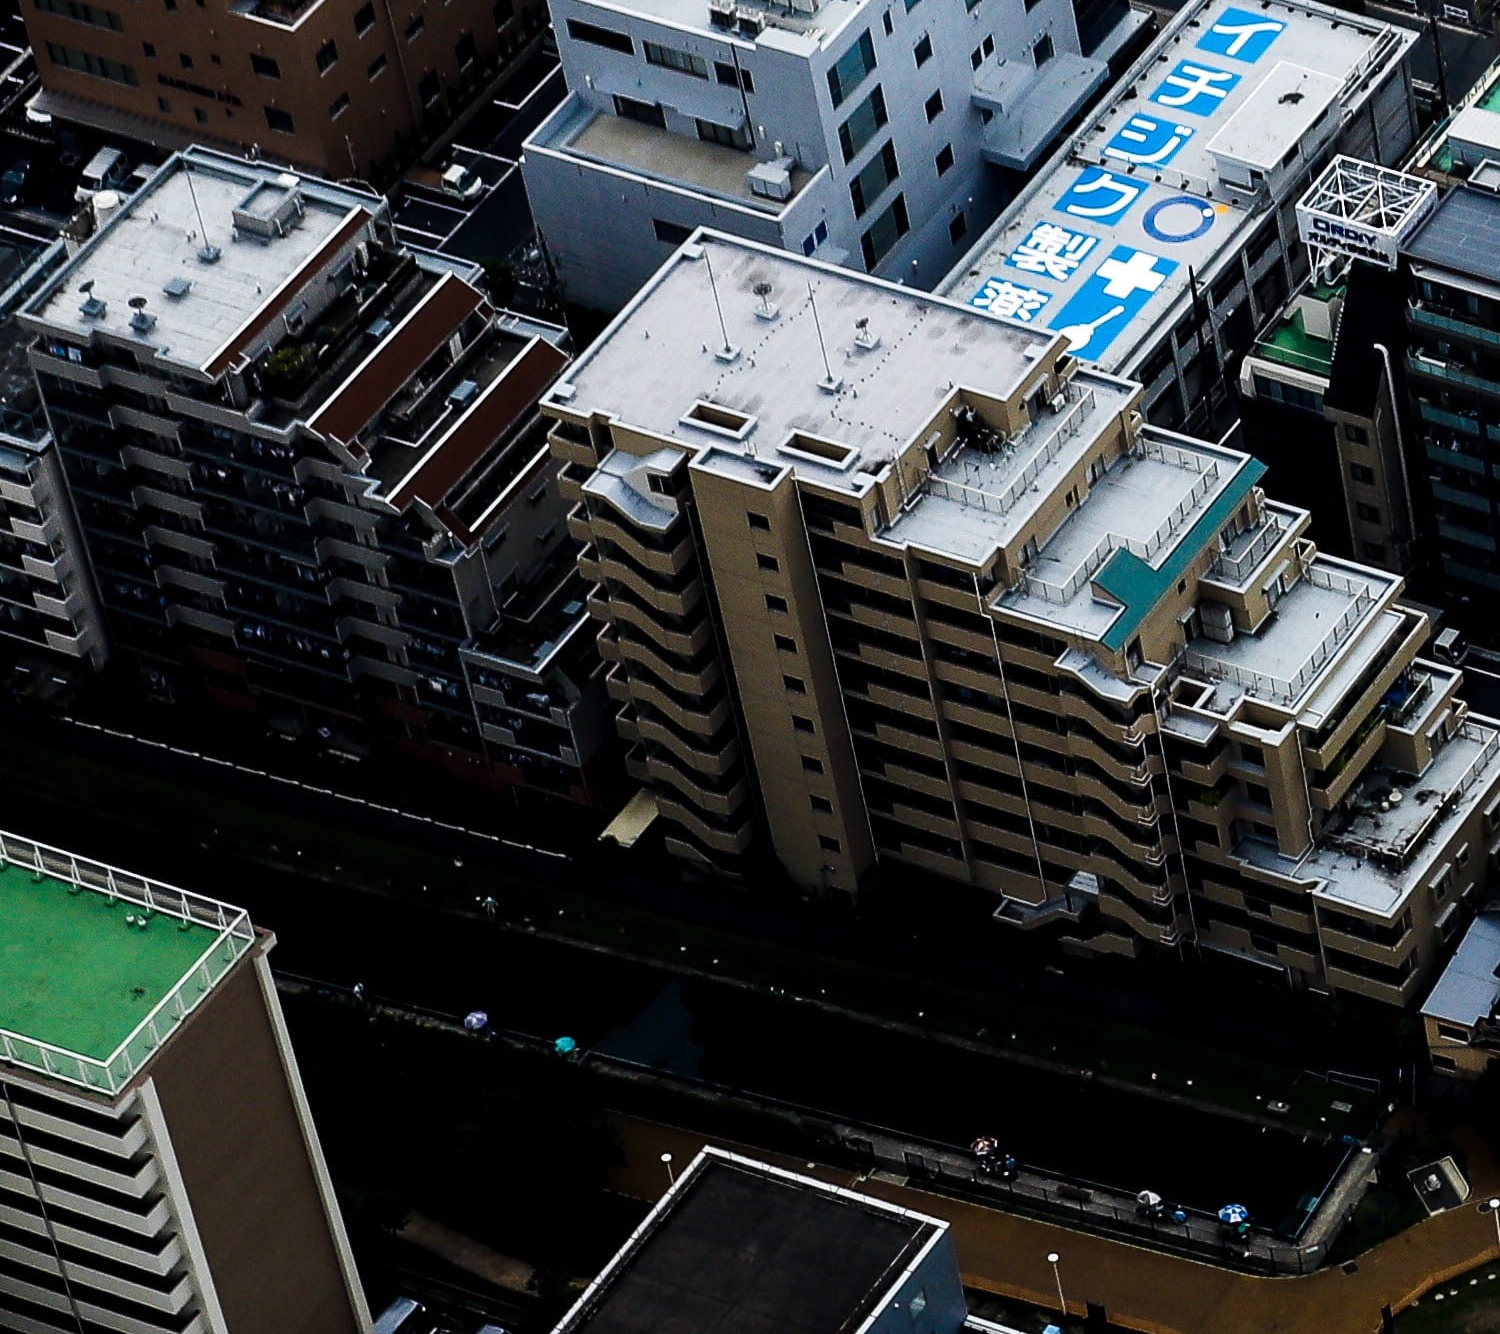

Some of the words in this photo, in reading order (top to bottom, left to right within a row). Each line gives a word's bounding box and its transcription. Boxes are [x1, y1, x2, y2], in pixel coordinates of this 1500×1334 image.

[972, 19, 1284, 322] イチジク製薬
[1312, 217, 1377, 247] ORDIY
